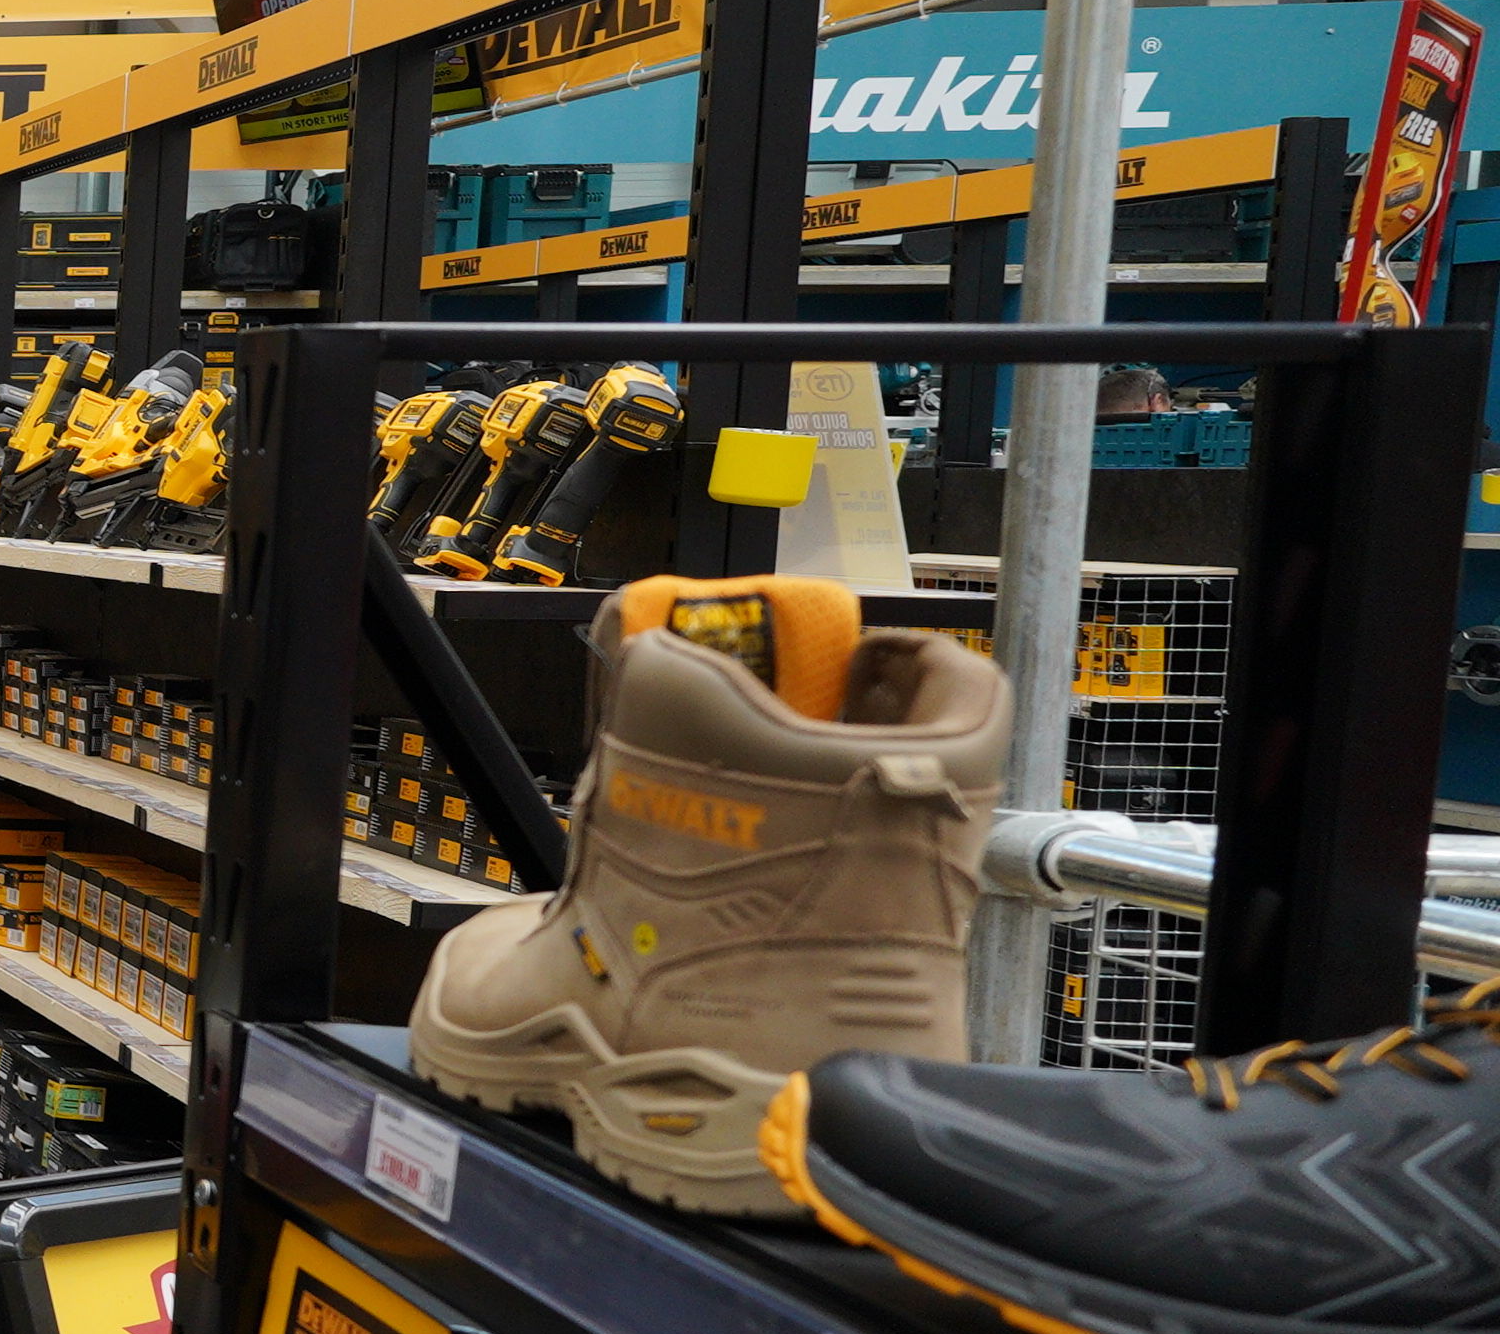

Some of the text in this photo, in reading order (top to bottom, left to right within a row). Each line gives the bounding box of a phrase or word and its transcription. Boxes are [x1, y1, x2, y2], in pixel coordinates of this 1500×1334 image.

[198, 41, 258, 88] DEWALT
[282, 110, 350, 130] IN STORE THIS
[19, 114, 61, 152] DEWALT
[599, 233, 648, 258] DEWALT
[443, 260, 482, 278] DEWALT
